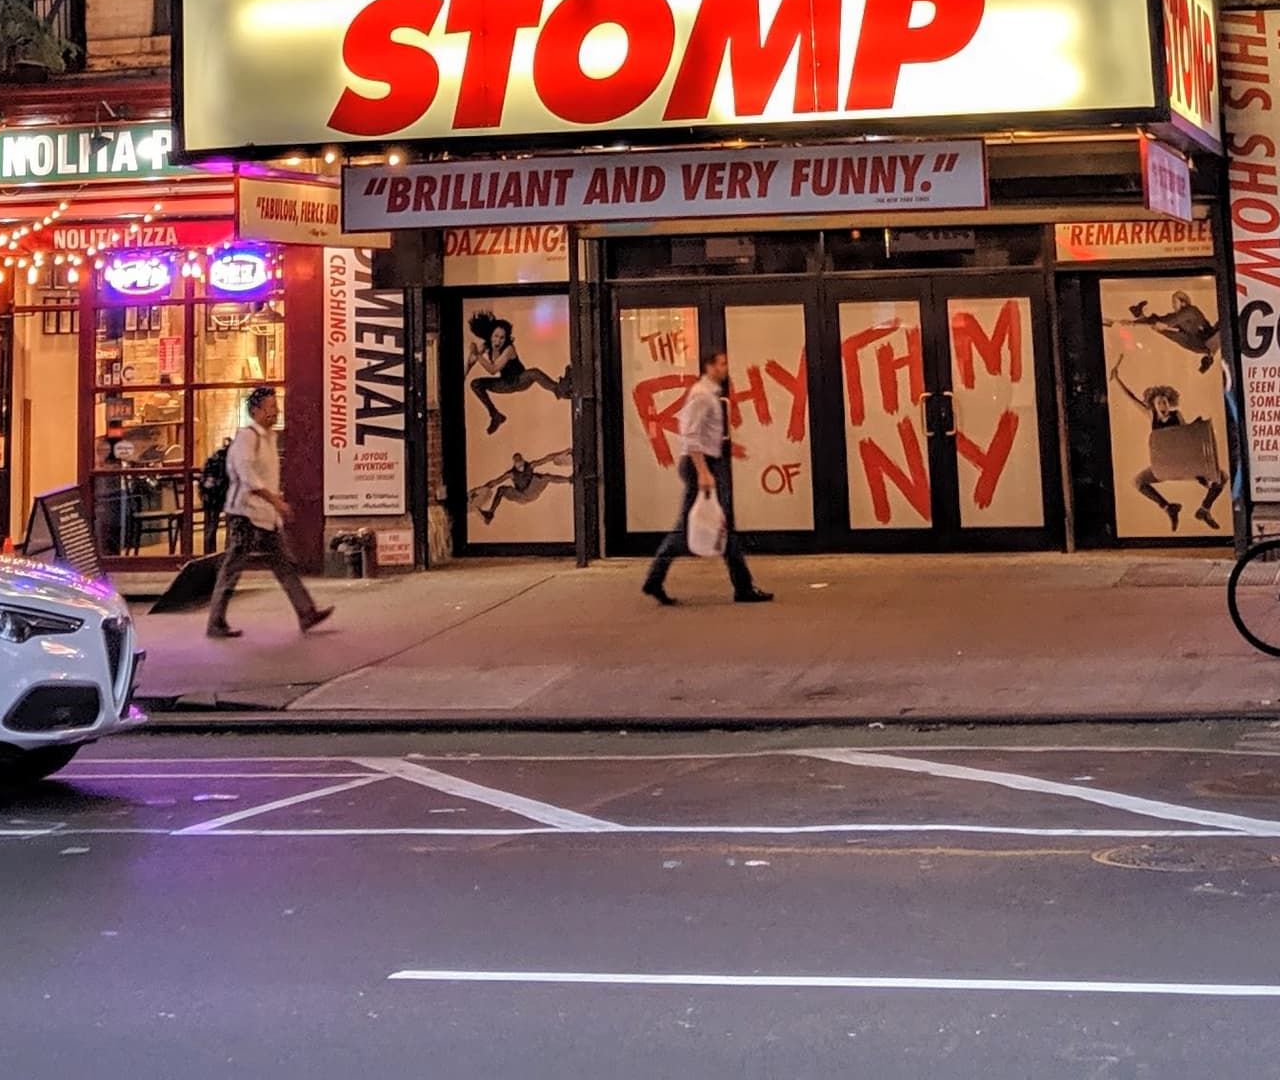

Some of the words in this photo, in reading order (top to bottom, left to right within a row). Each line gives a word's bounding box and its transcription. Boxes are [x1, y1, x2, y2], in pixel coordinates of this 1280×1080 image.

[1221, 10, 1273, 112] THIS
[2, 130, 139, 178] NOLITA
[363, 168, 574, 215] "BRILLIANT
[583, 165, 667, 206] AND
[680, 160, 779, 202] VERY
[789, 152, 959, 199] FUNNY."
[300, 201, 324, 225] FIERCE
[53, 228, 116, 250] NOLITA
[123, 225, 179, 249] PIZZA
[444, 225, 567, 257] DAZZLING!
[328, 254, 347, 347] CRASHING,
[640, 327, 688, 366] THE
[1248, 366, 1258, 379] IF
[1249, 380, 1276, 393] SEEN
[761, 462, 802, 495] OF
